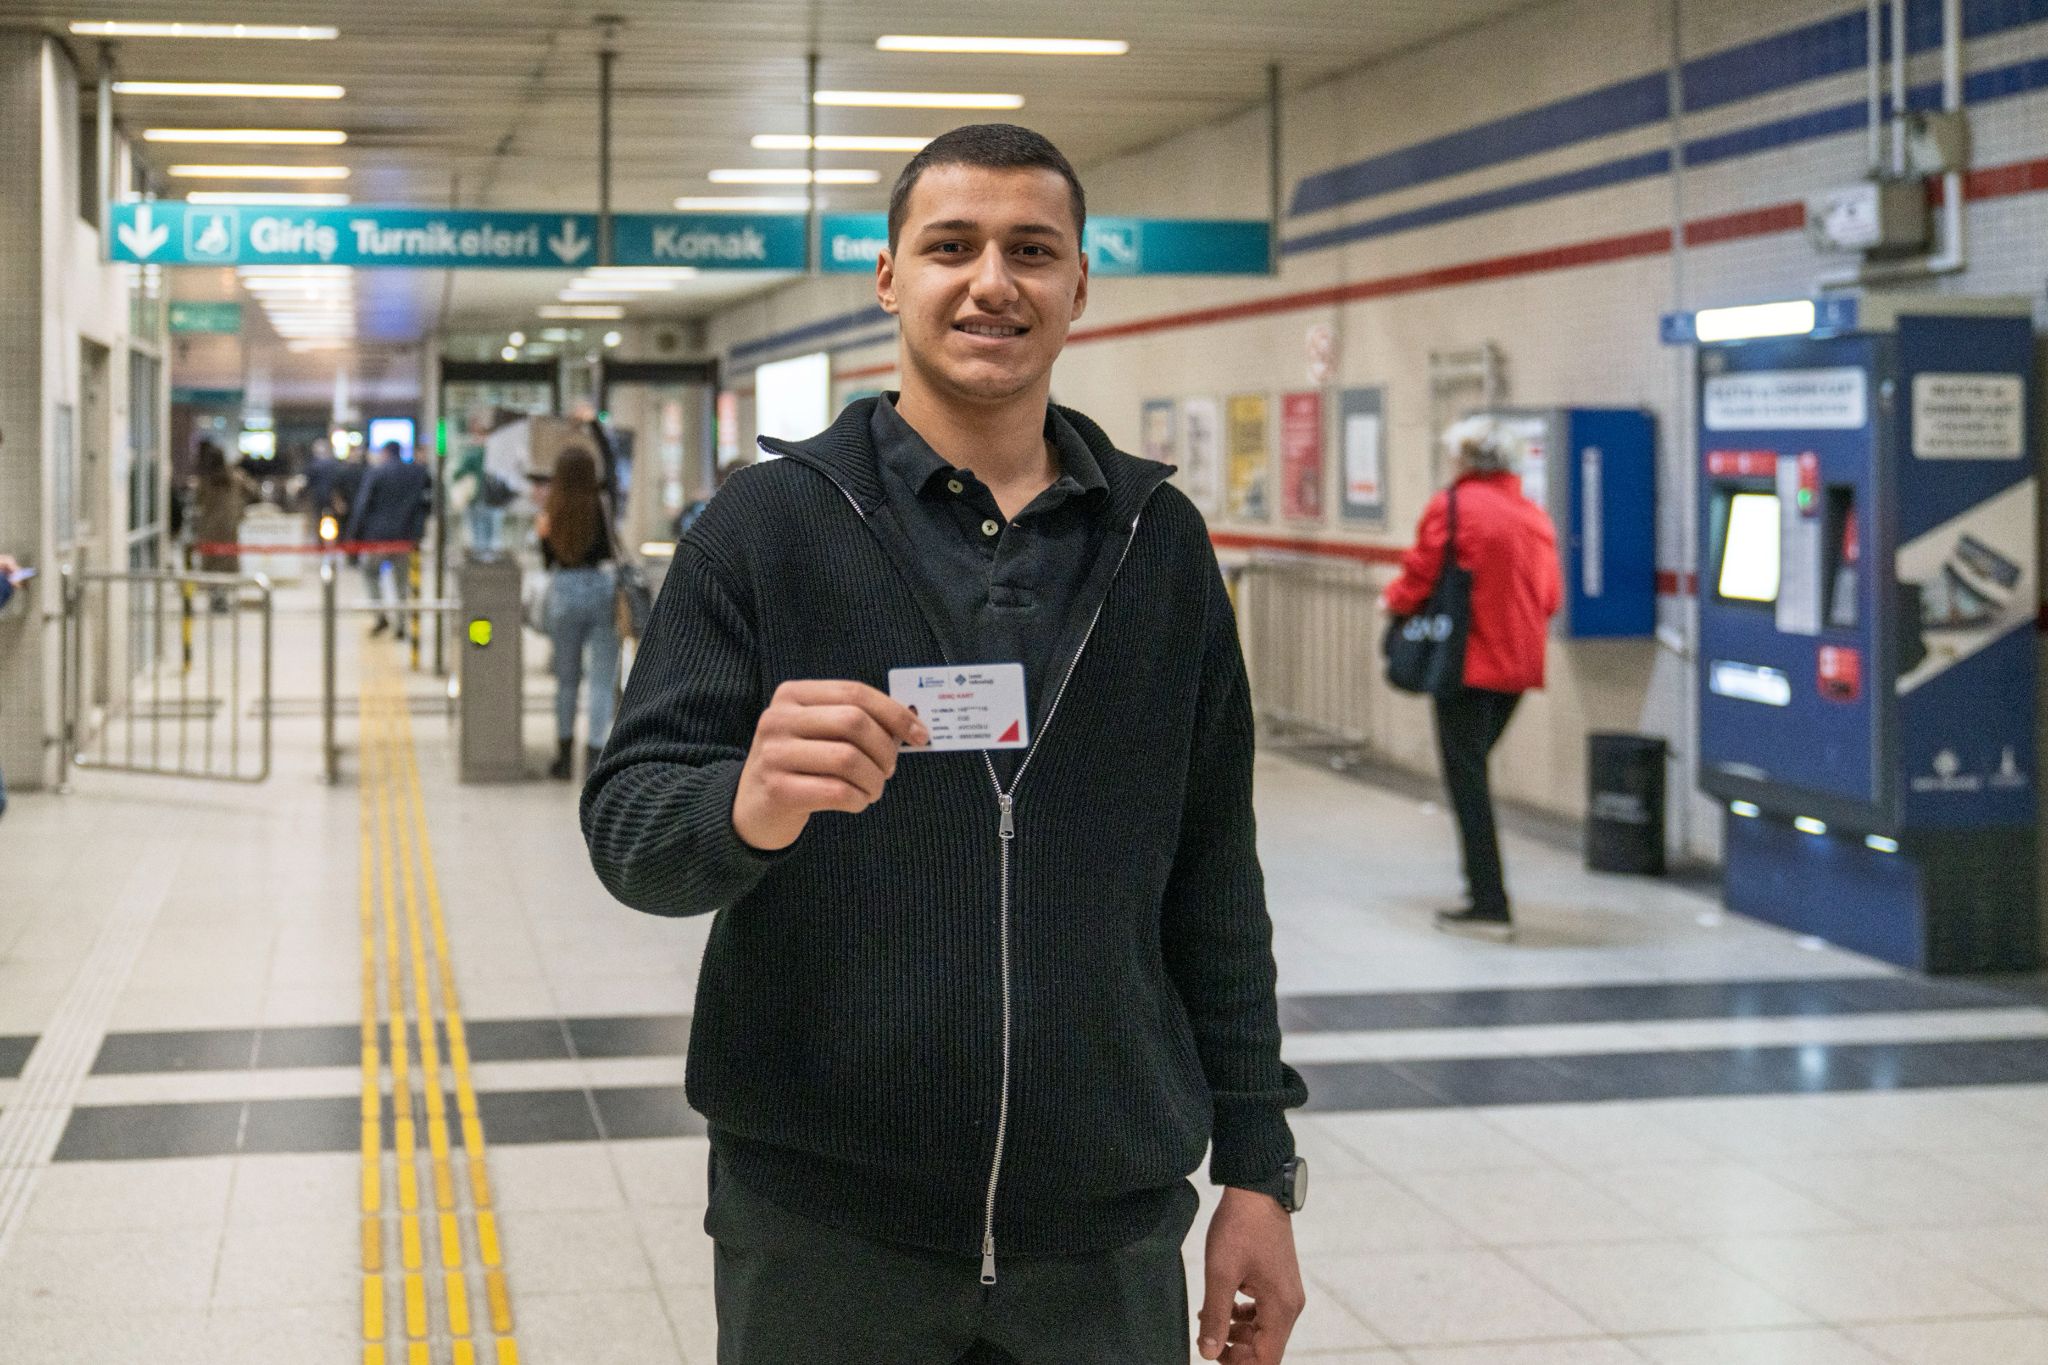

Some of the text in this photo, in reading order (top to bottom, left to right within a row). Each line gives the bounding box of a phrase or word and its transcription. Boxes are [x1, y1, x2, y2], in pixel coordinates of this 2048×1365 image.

[249, 216, 540, 261] Giriş Turnikeleri
[652, 225, 765, 260] Konak
